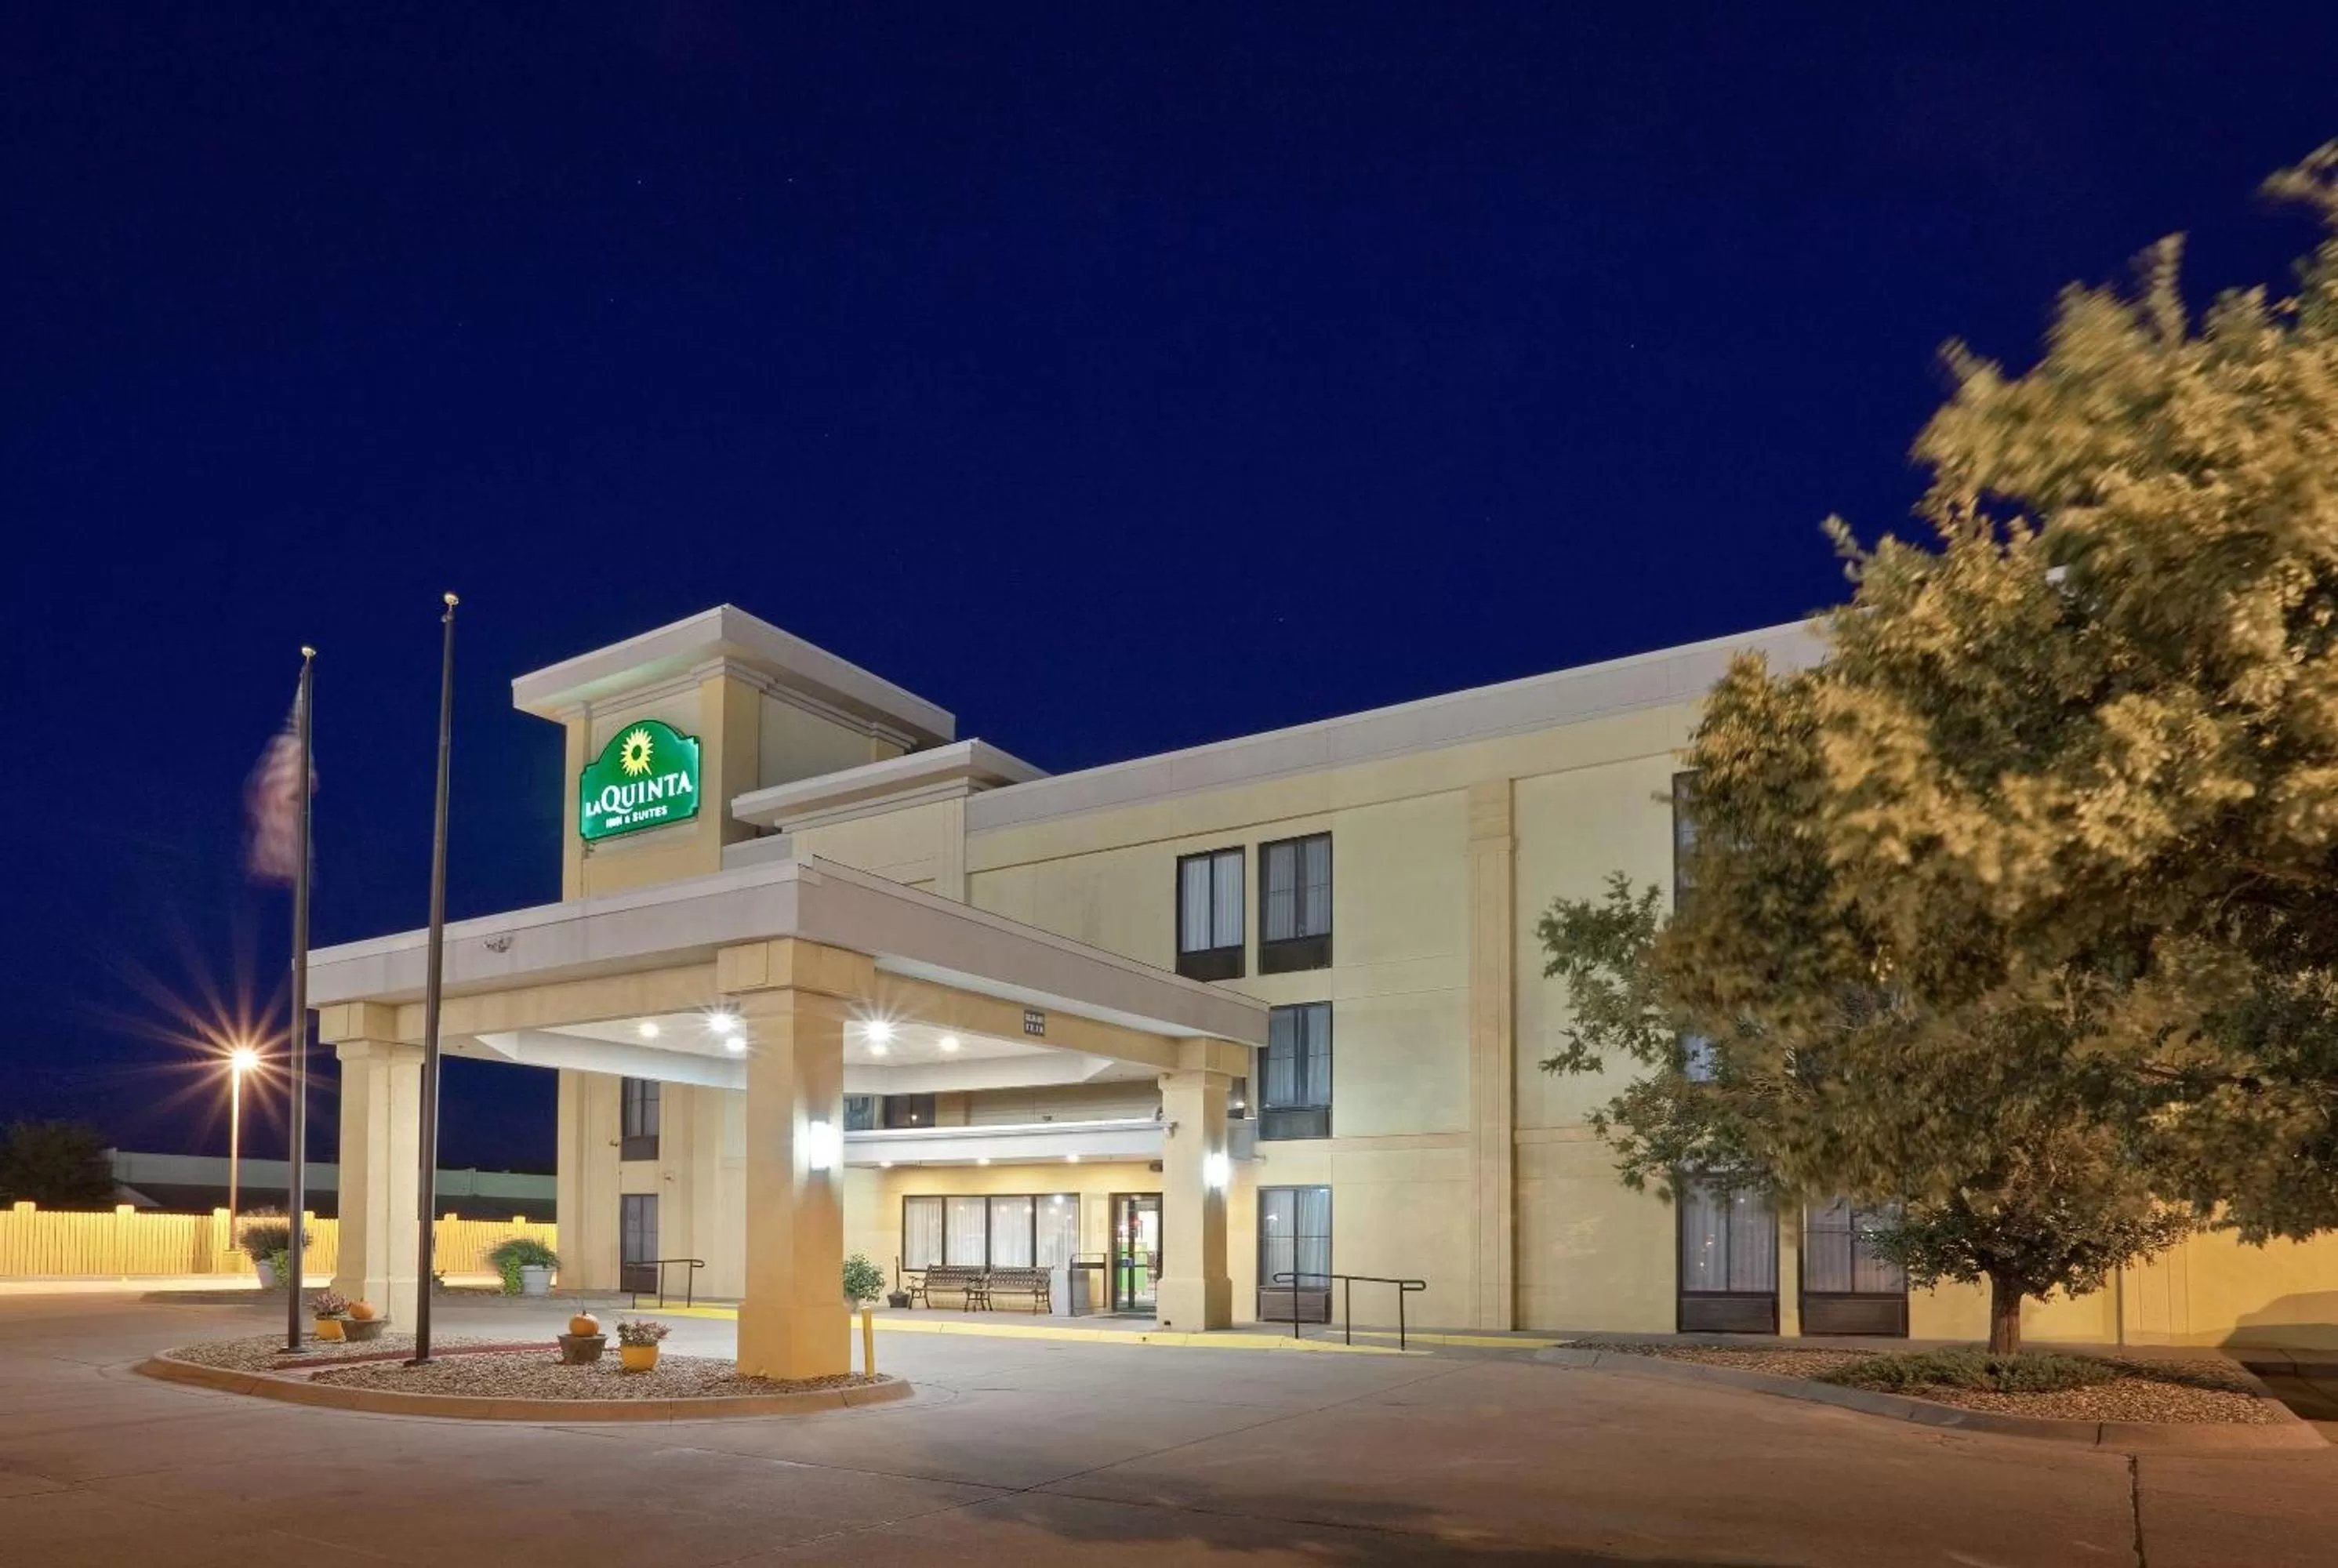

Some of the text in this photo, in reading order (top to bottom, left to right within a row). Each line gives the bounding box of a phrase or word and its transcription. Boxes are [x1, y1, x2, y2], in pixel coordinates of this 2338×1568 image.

[586, 770, 693, 817] LA QUINTA
[633, 805, 668, 822] SUITES
